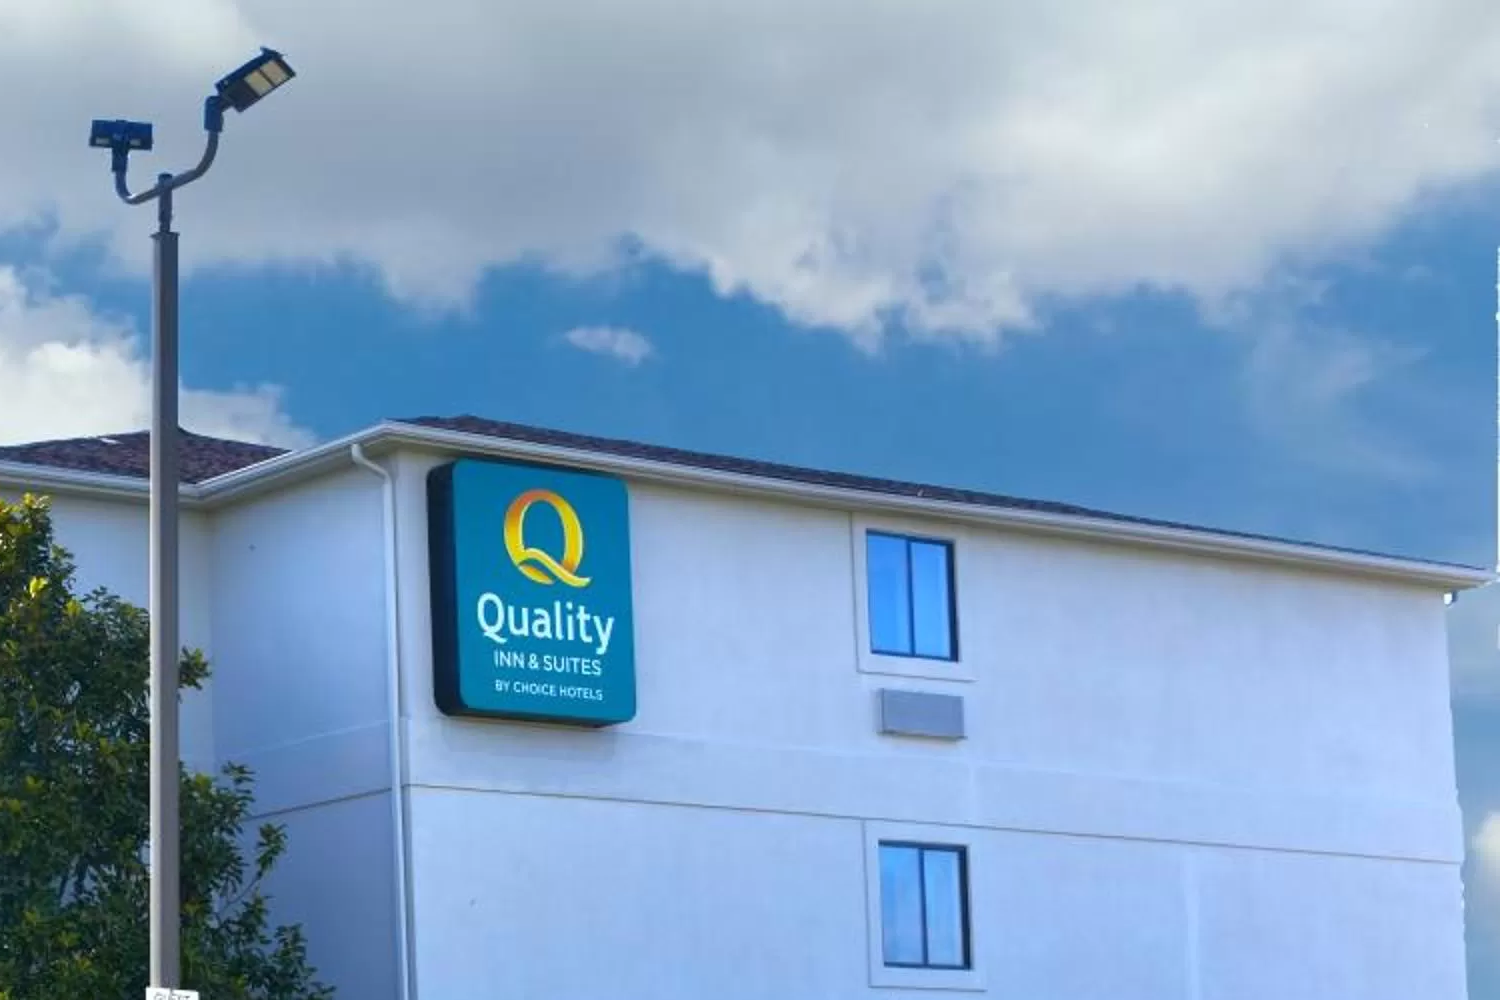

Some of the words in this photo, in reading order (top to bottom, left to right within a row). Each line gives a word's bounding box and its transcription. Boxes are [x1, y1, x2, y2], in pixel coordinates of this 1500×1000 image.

[503, 489, 592, 588] Q
[477, 592, 614, 655] Quality
[493, 649, 525, 669] INN
[527, 652, 539, 670] &
[543, 655, 602, 676] SUITES
[495, 679, 510, 692] BY
[513, 681, 557, 697] CHOICE
[559, 685, 603, 701] HOTELS
